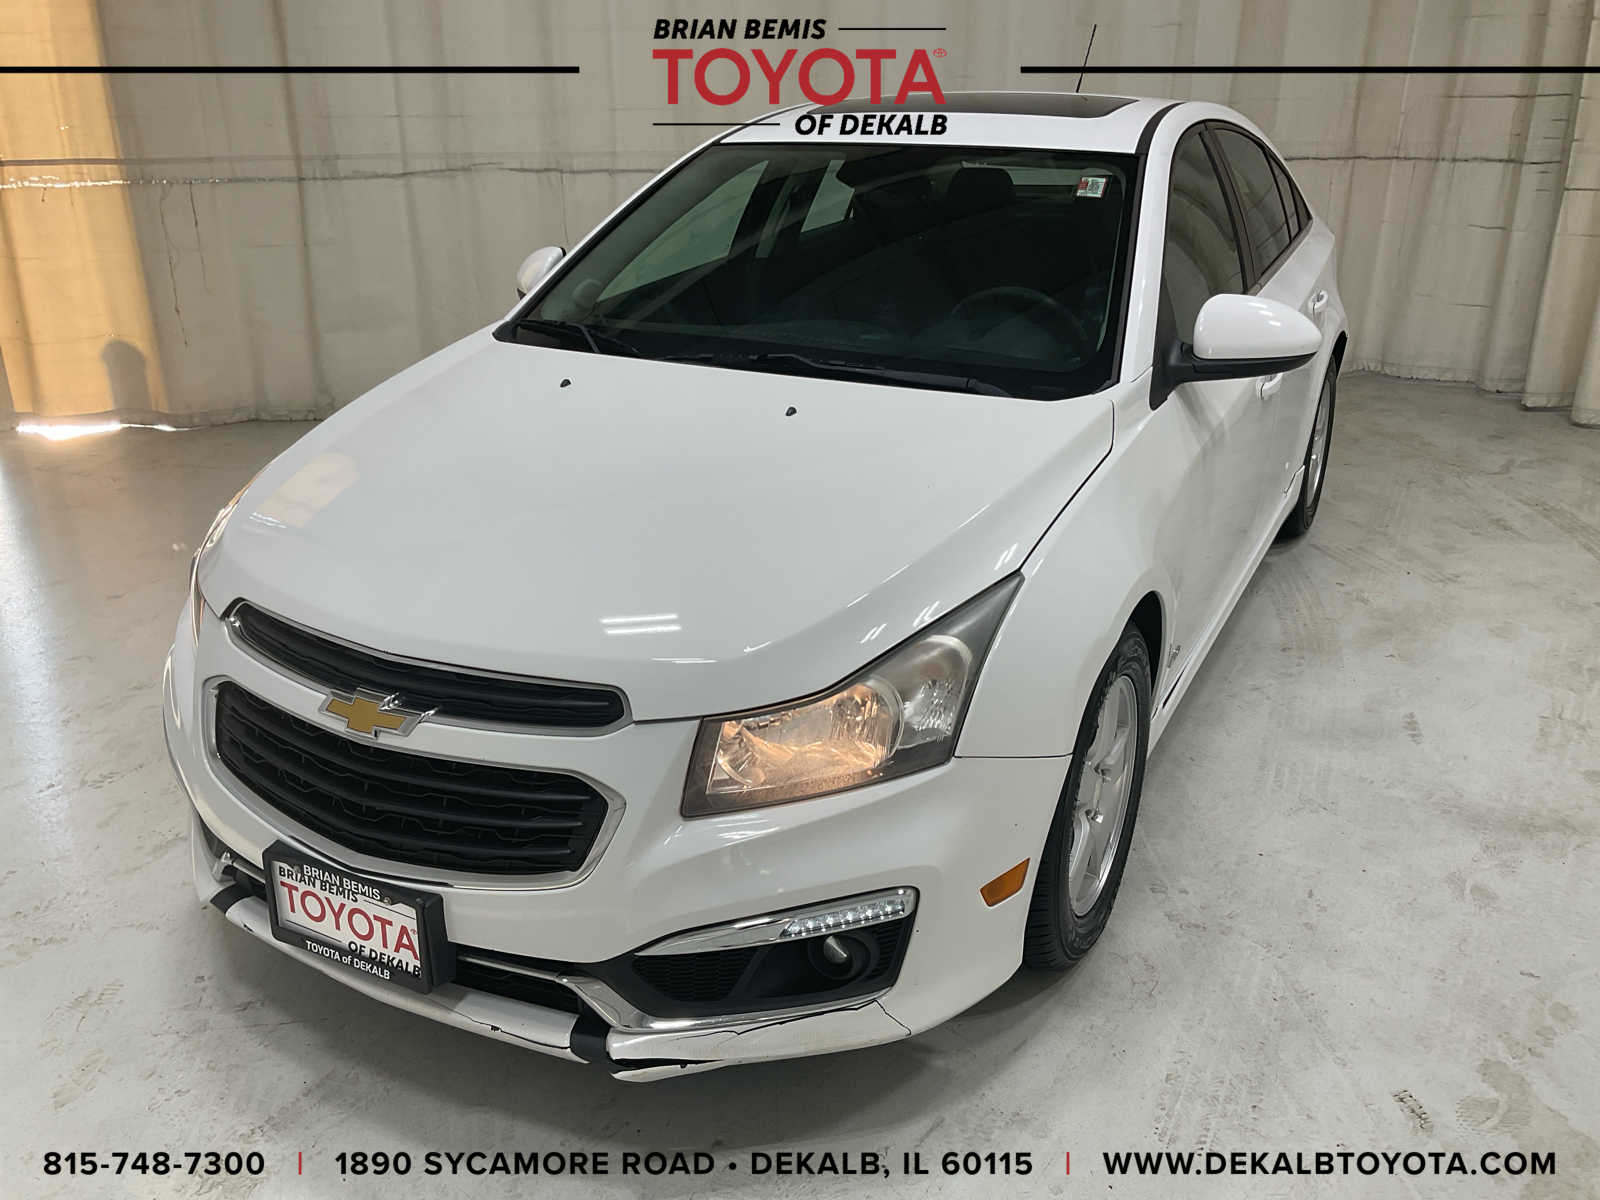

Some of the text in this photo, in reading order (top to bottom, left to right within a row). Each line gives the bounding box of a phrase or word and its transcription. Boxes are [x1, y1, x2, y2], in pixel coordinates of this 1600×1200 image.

[278, 866, 359, 903] BRIAN BEMIS
[303, 864, 381, 900] BRIAN BEMIS
[280, 881, 420, 961] TOYOTA
[305, 940, 341, 963] TOYOTA
[353, 957, 391, 980] DEKALB
[348, 940, 422, 978] OF DEKALB
